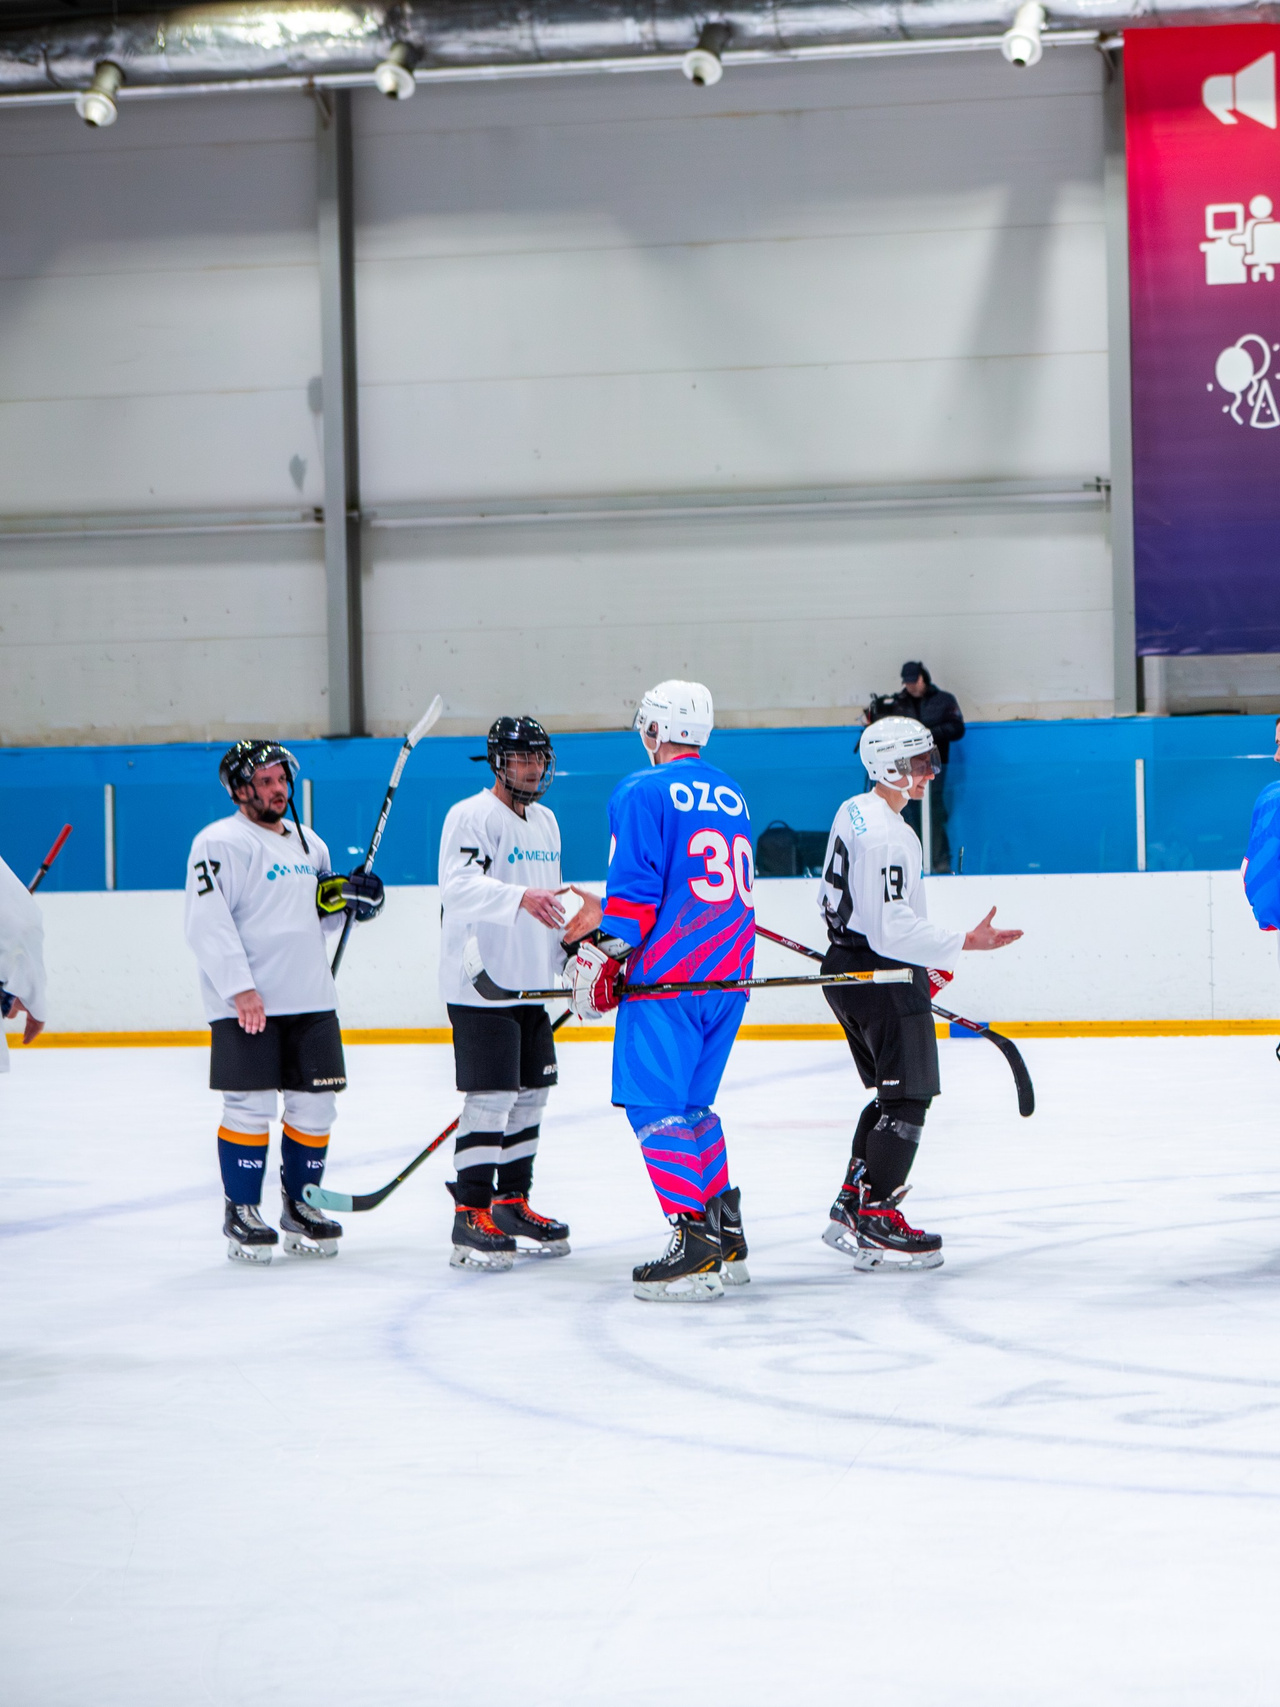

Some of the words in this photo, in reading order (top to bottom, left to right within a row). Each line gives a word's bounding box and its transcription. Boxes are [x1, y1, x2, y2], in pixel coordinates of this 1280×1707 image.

[669, 781, 750, 820] OZO
[688, 828, 755, 910] 30
[881, 865, 904, 903] 19
